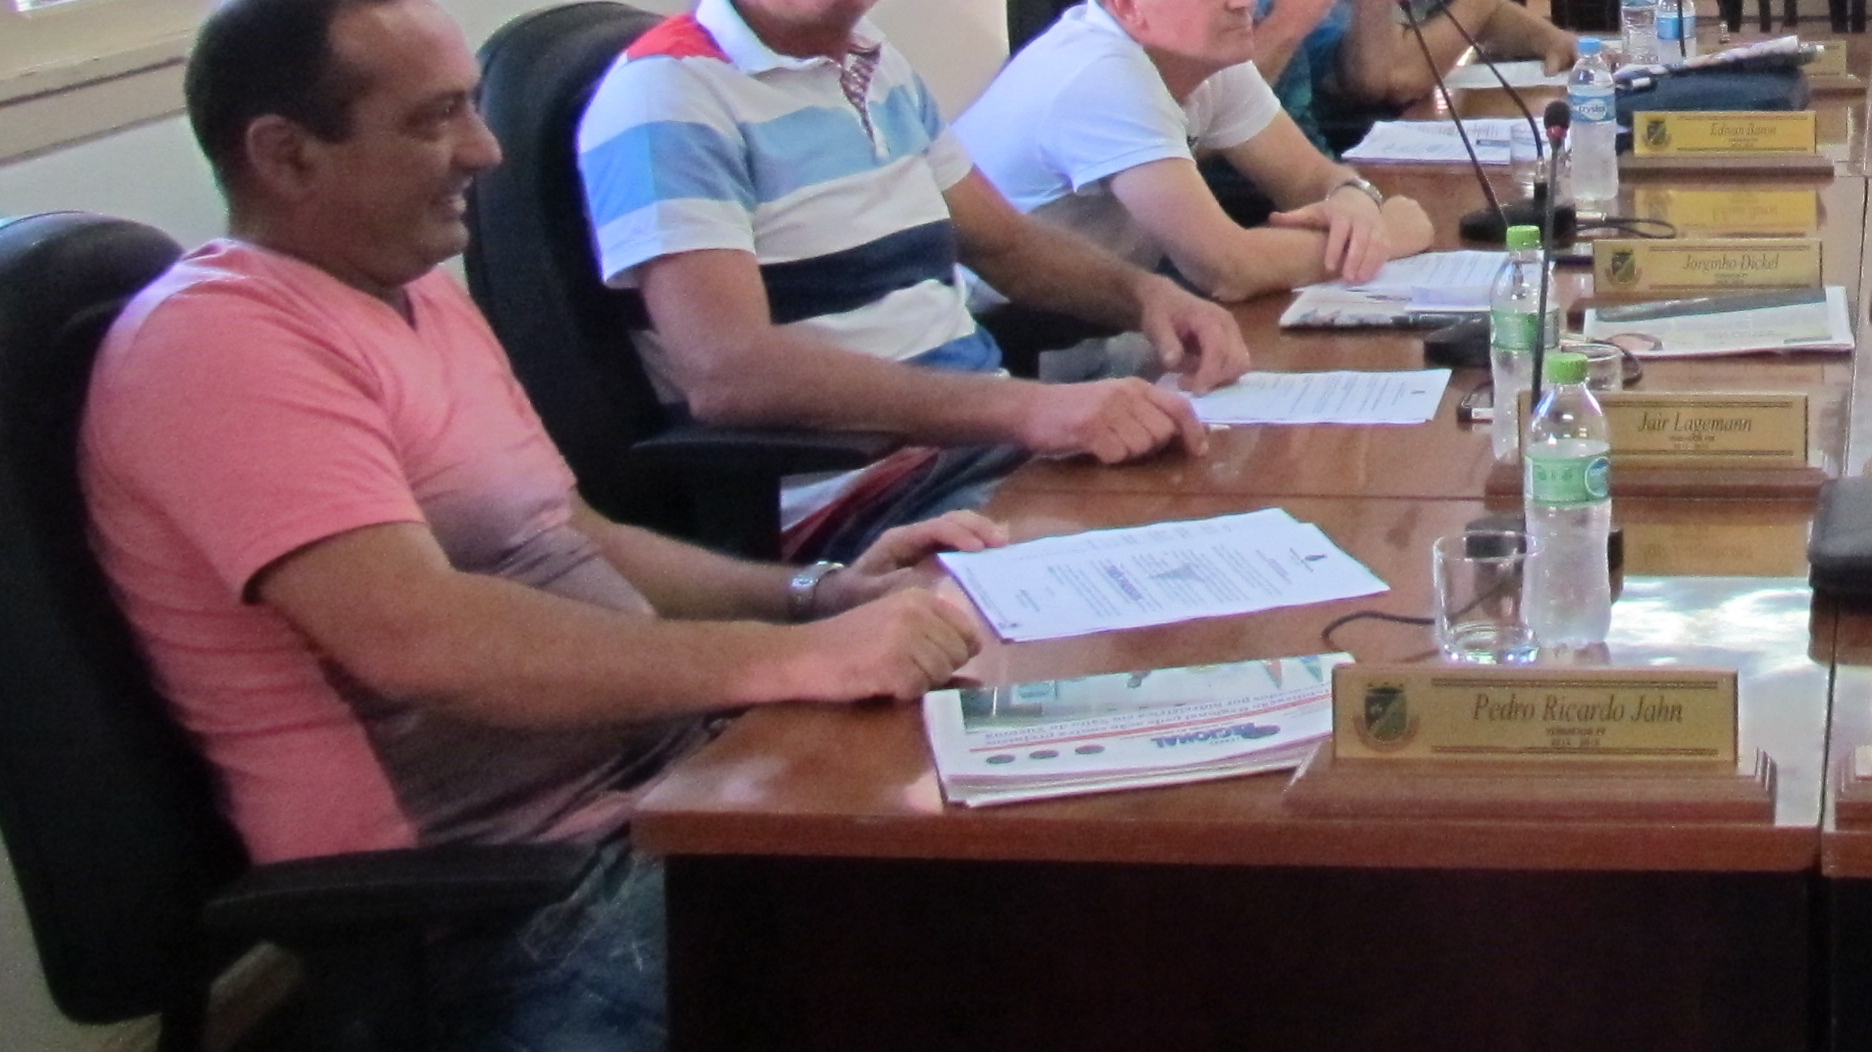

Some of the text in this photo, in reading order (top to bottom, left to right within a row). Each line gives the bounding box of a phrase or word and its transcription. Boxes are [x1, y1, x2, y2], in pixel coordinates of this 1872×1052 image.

[1637, 412, 1753, 434] Jair Lagemann
[1473, 692, 1684, 723] Pedro Ricardo Jahn
